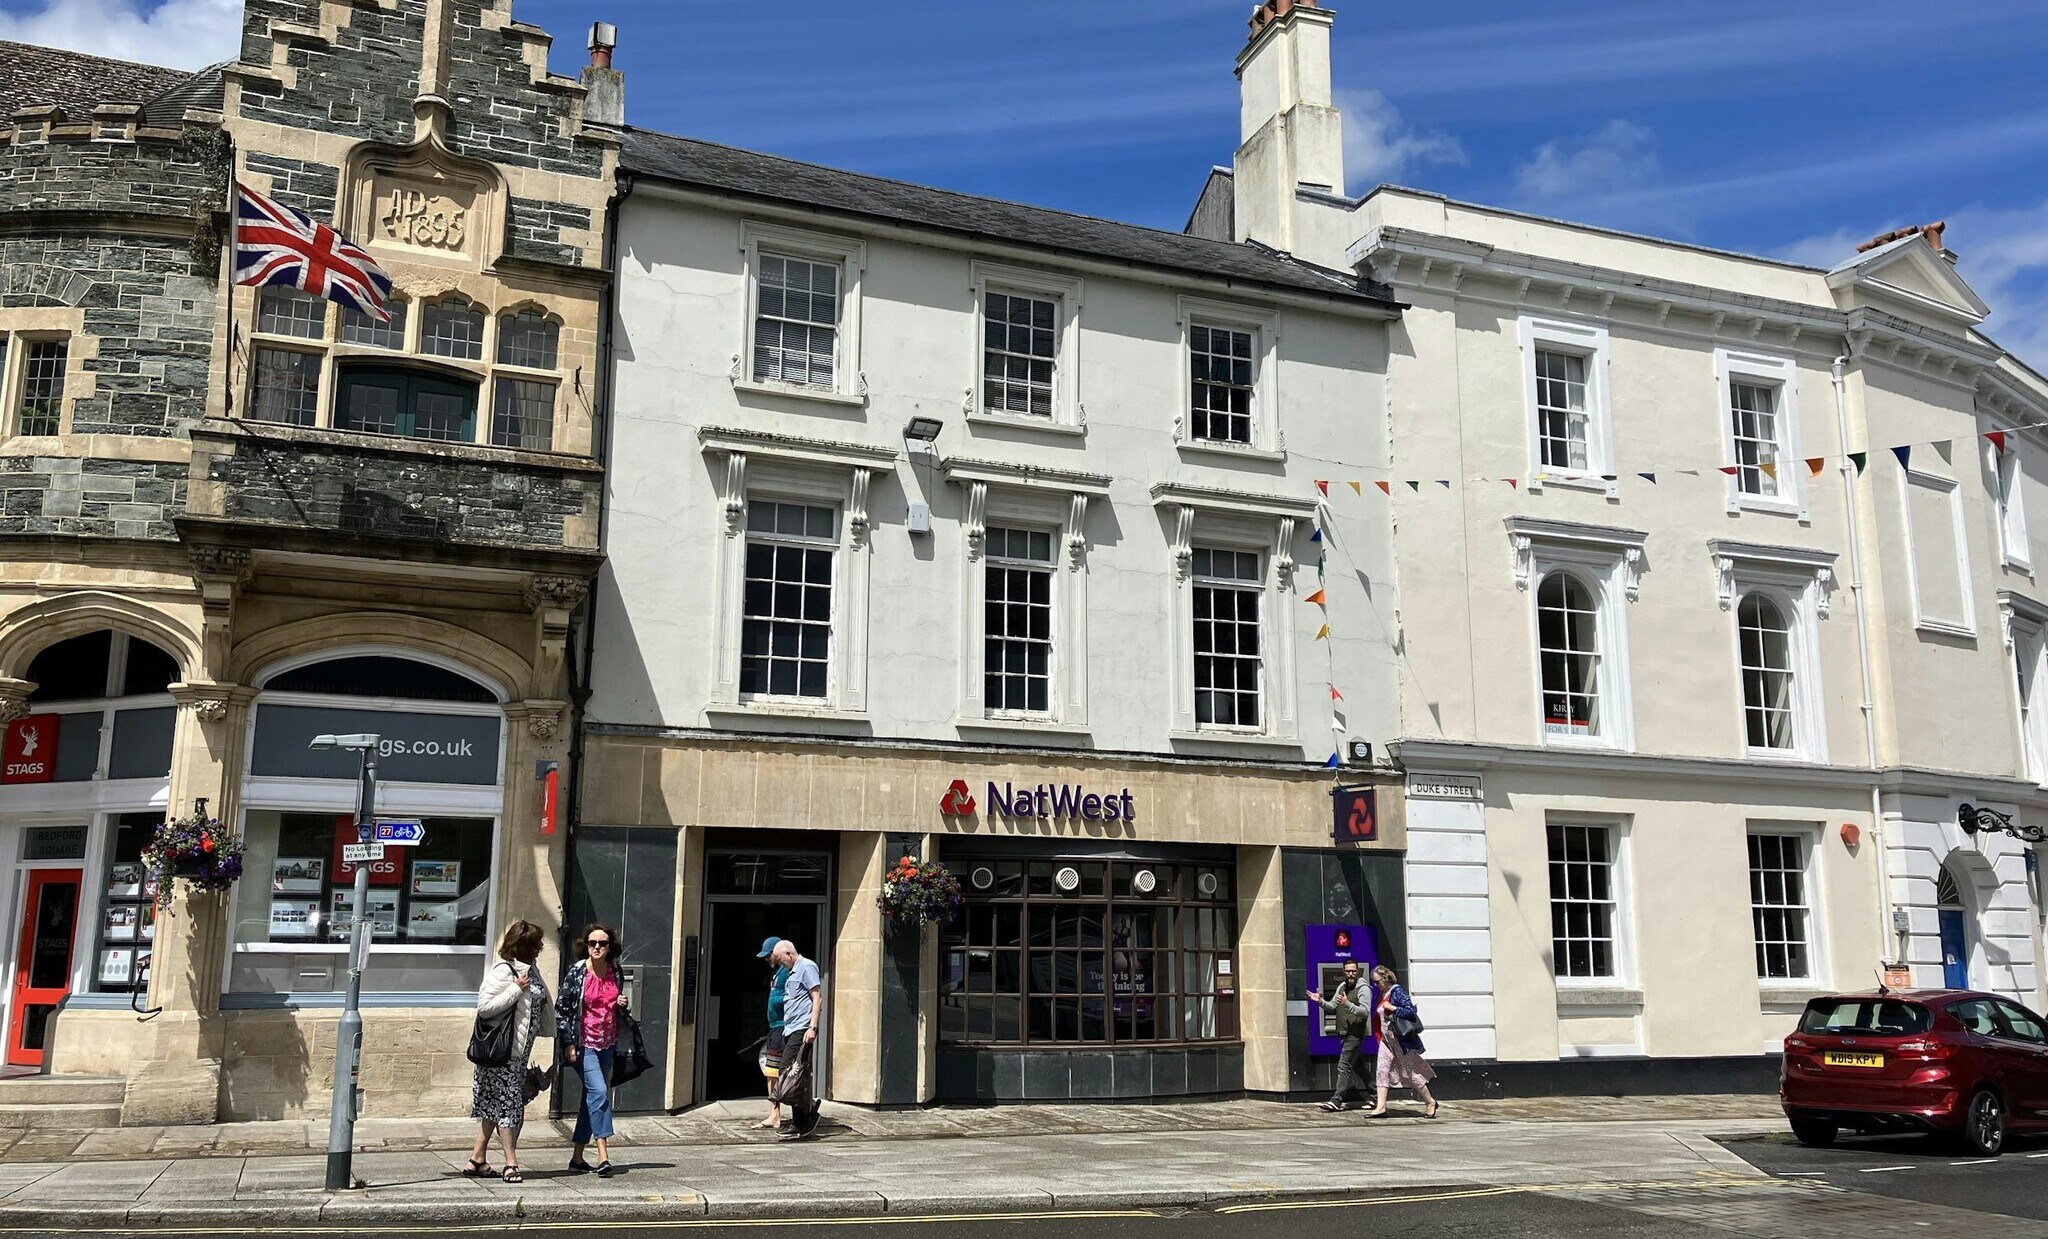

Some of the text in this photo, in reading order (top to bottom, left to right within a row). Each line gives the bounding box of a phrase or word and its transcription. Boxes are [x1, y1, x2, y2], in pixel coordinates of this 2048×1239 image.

[1553, 704, 1576, 713] KIRY
[1548, 725, 1580, 734] FOR SLE
[6, 762, 44, 775] STAGS
[1416, 783, 1474, 795] DUKE STREET
[986, 781, 1136, 821] NatWest
[38, 831, 82, 841] BEDFORD
[381, 828, 392, 836] 27
[39, 845, 78, 855] SQUARE
[38, 938, 68, 949] STAGS
[1120, 971, 1129, 980] is
[1831, 1053, 1877, 1065] WD19 KPV
